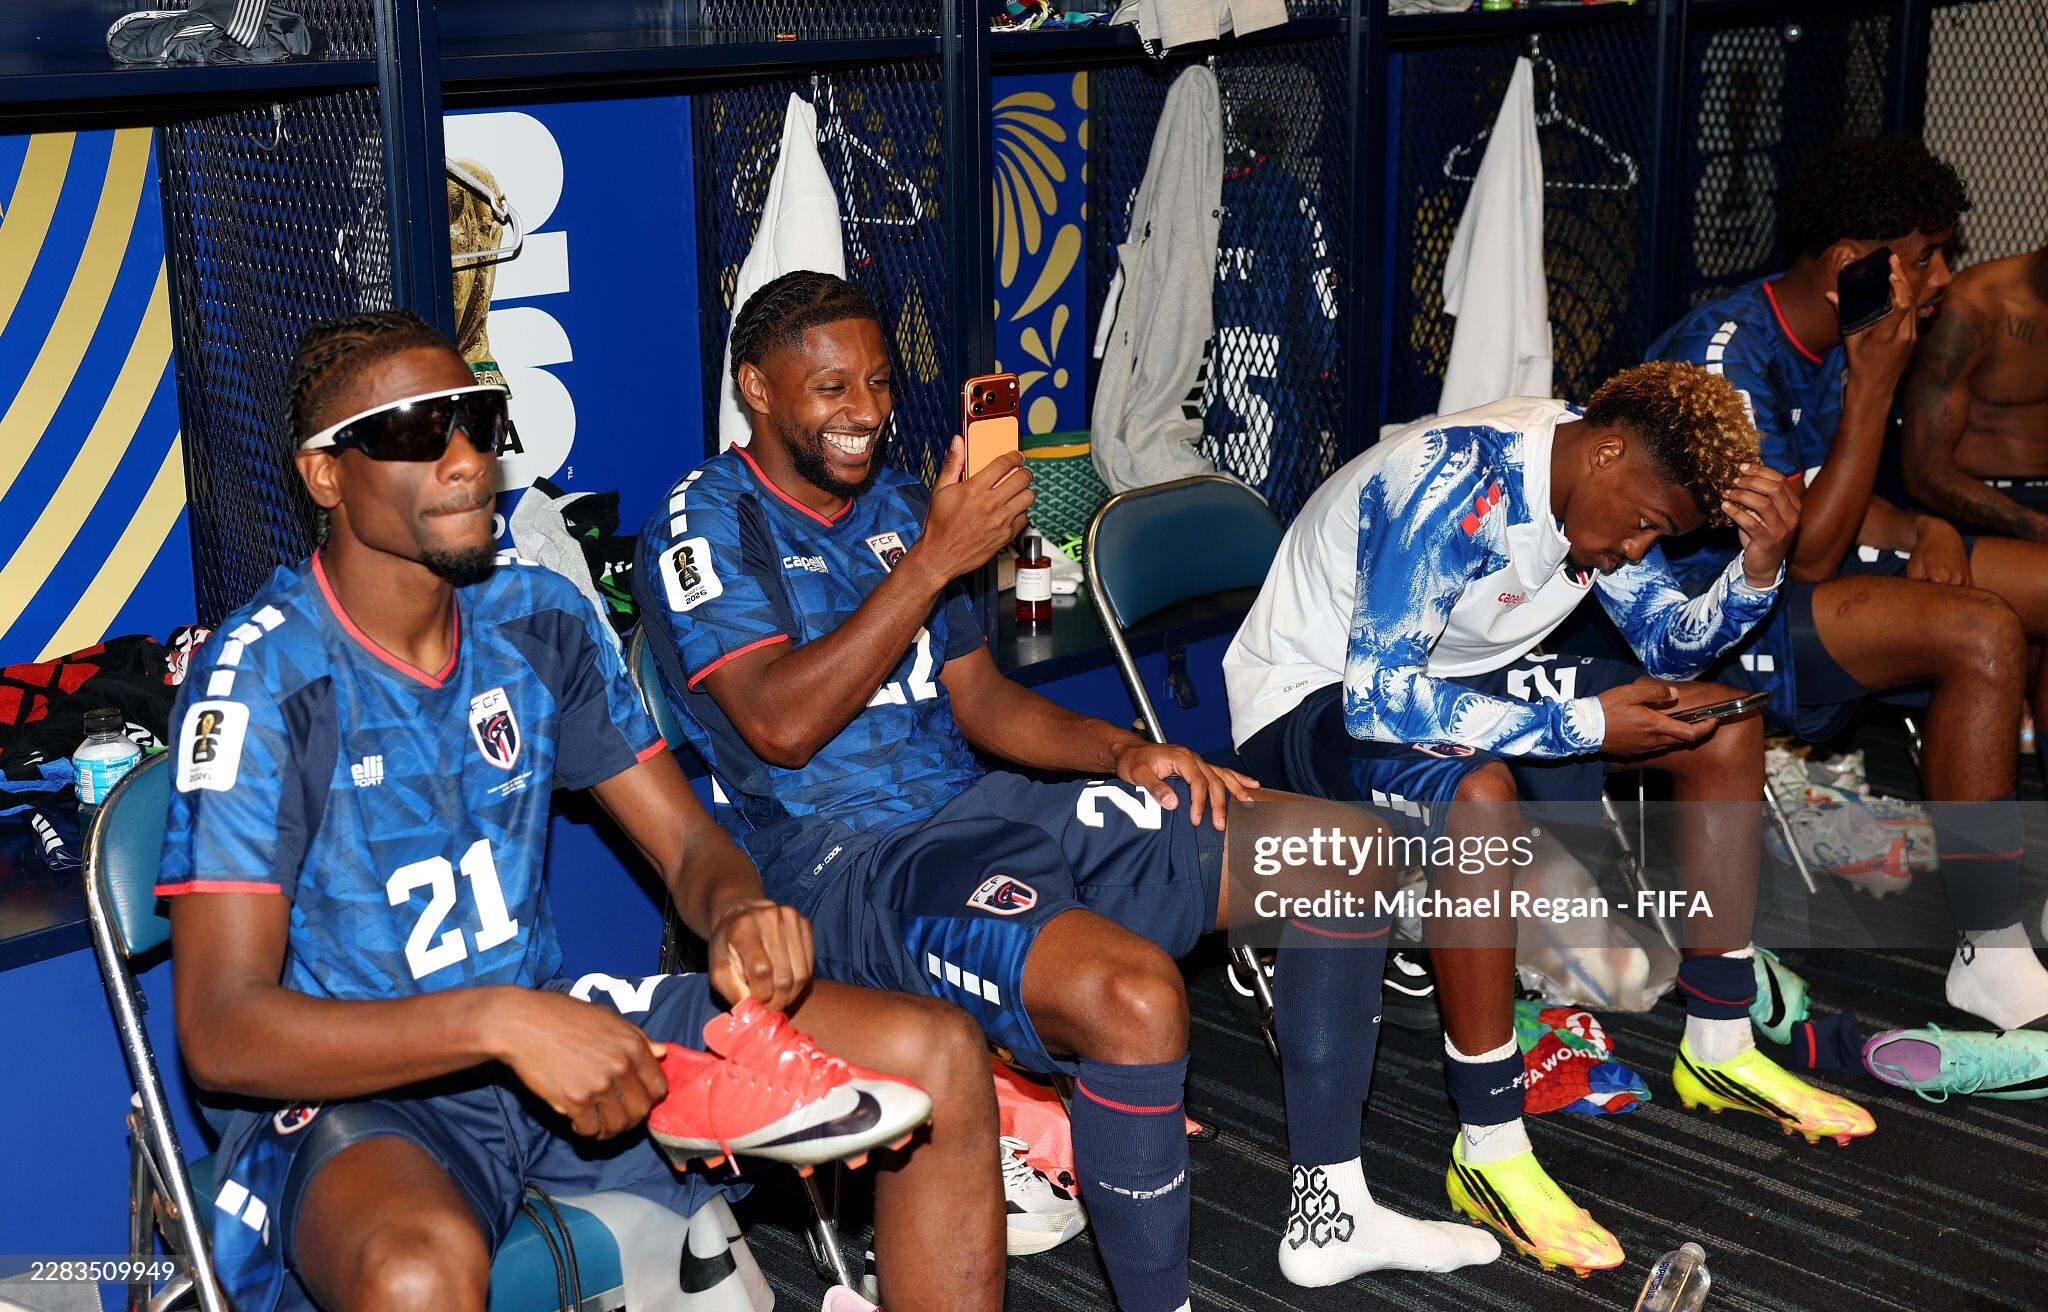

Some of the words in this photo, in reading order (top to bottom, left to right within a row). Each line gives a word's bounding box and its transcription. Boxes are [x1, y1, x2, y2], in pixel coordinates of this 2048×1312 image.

[871, 535, 896, 549] FCF
[783, 555, 828, 571] capelli
[685, 589, 708, 605] 2026
[470, 692, 502, 715] FCF
[973, 876, 1000, 903] FCF
[386, 838, 519, 980] 21
